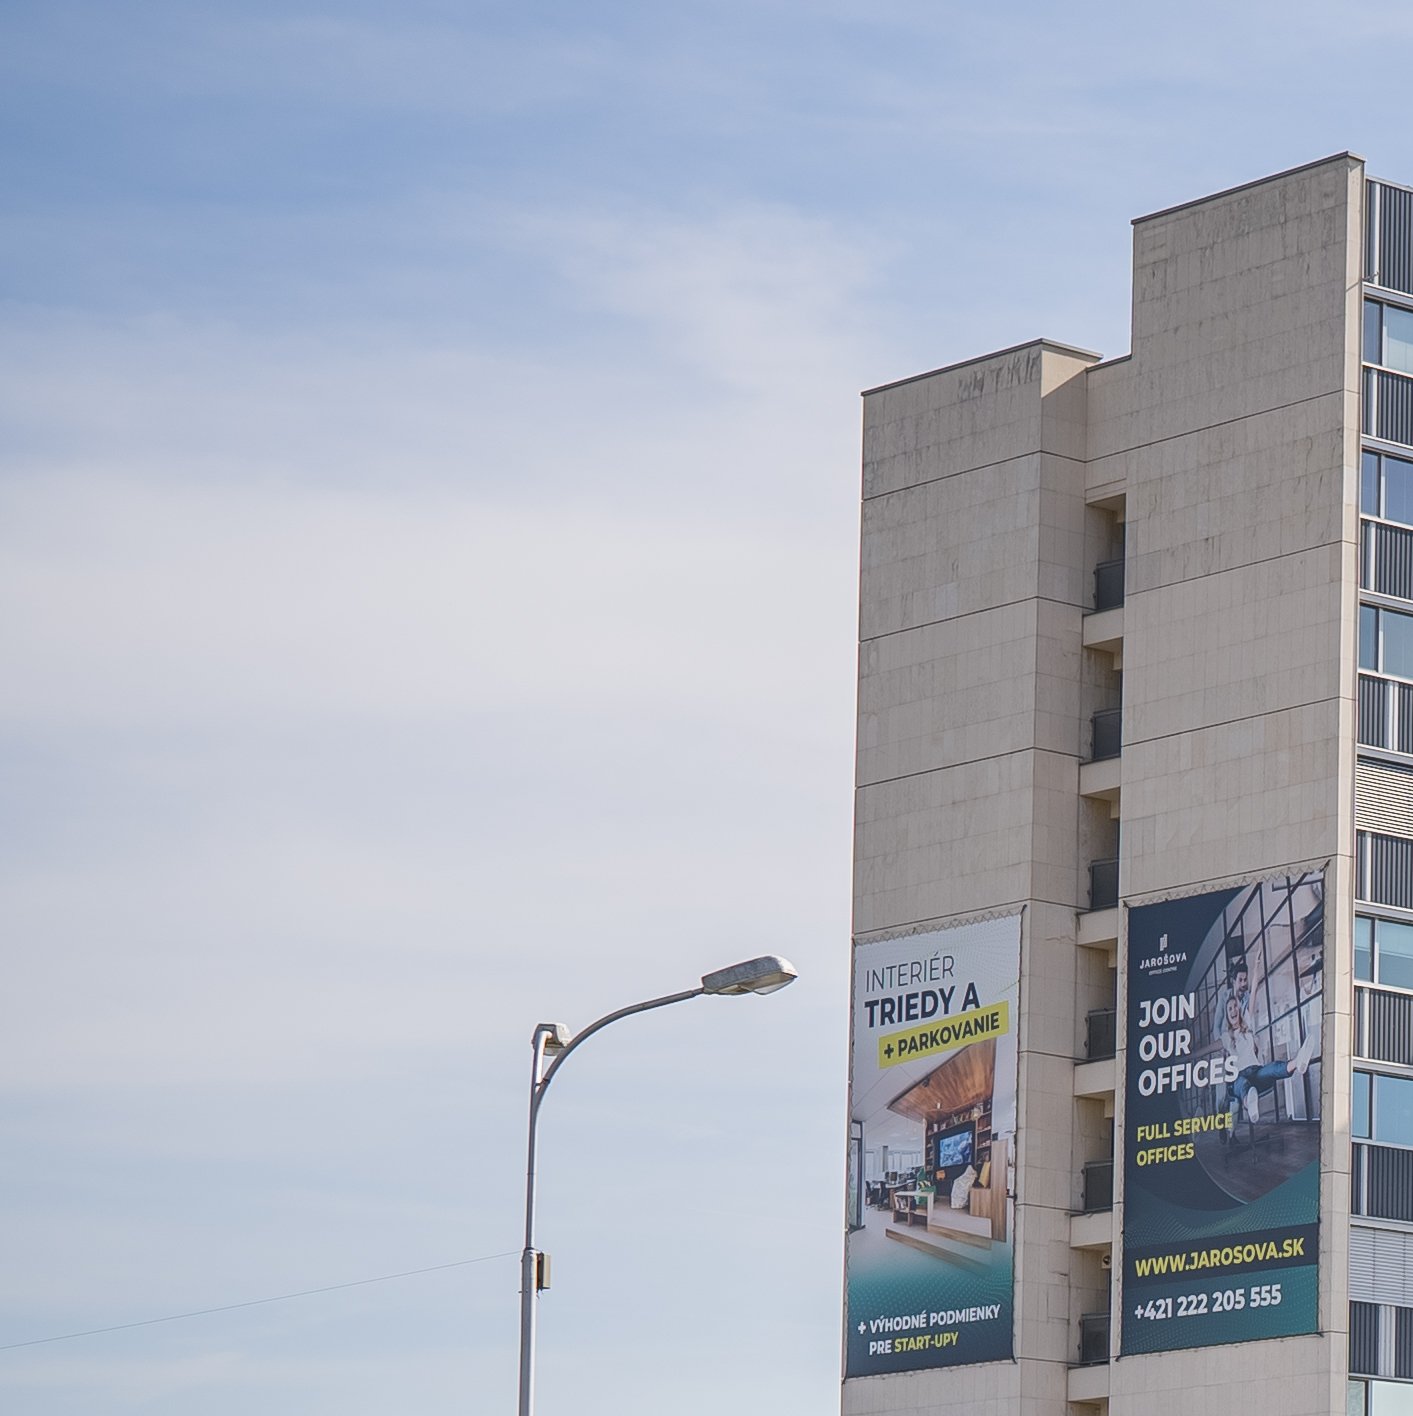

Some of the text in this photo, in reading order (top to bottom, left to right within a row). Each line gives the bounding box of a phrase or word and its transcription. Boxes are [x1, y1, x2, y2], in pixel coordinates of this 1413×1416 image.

[866, 952, 955, 993] INTERIÉR
[1139, 952, 1187, 970] JAROŠOVA
[864, 982, 981, 1028] TRIEDY A
[1138, 992, 1195, 1028] JOIN
[898, 1011, 1000, 1057] PARKOVANIE
[1138, 1028, 1191, 1062] OUR
[1138, 1055, 1240, 1097] OFFICES
[1137, 1112, 1233, 1142] FULL SERVICE
[1136, 1143, 1195, 1167] OFFICES
[1135, 1237, 1305, 1277] WWW.JAROSOVA.SK
[869, 1310, 927, 1334] VÝHODNÉ
[929, 1304, 1001, 1327] PODMIENKY
[1134, 1283, 1282, 1321] +421 222 205 555
[869, 1332, 959, 1356] PRE START-UPY
